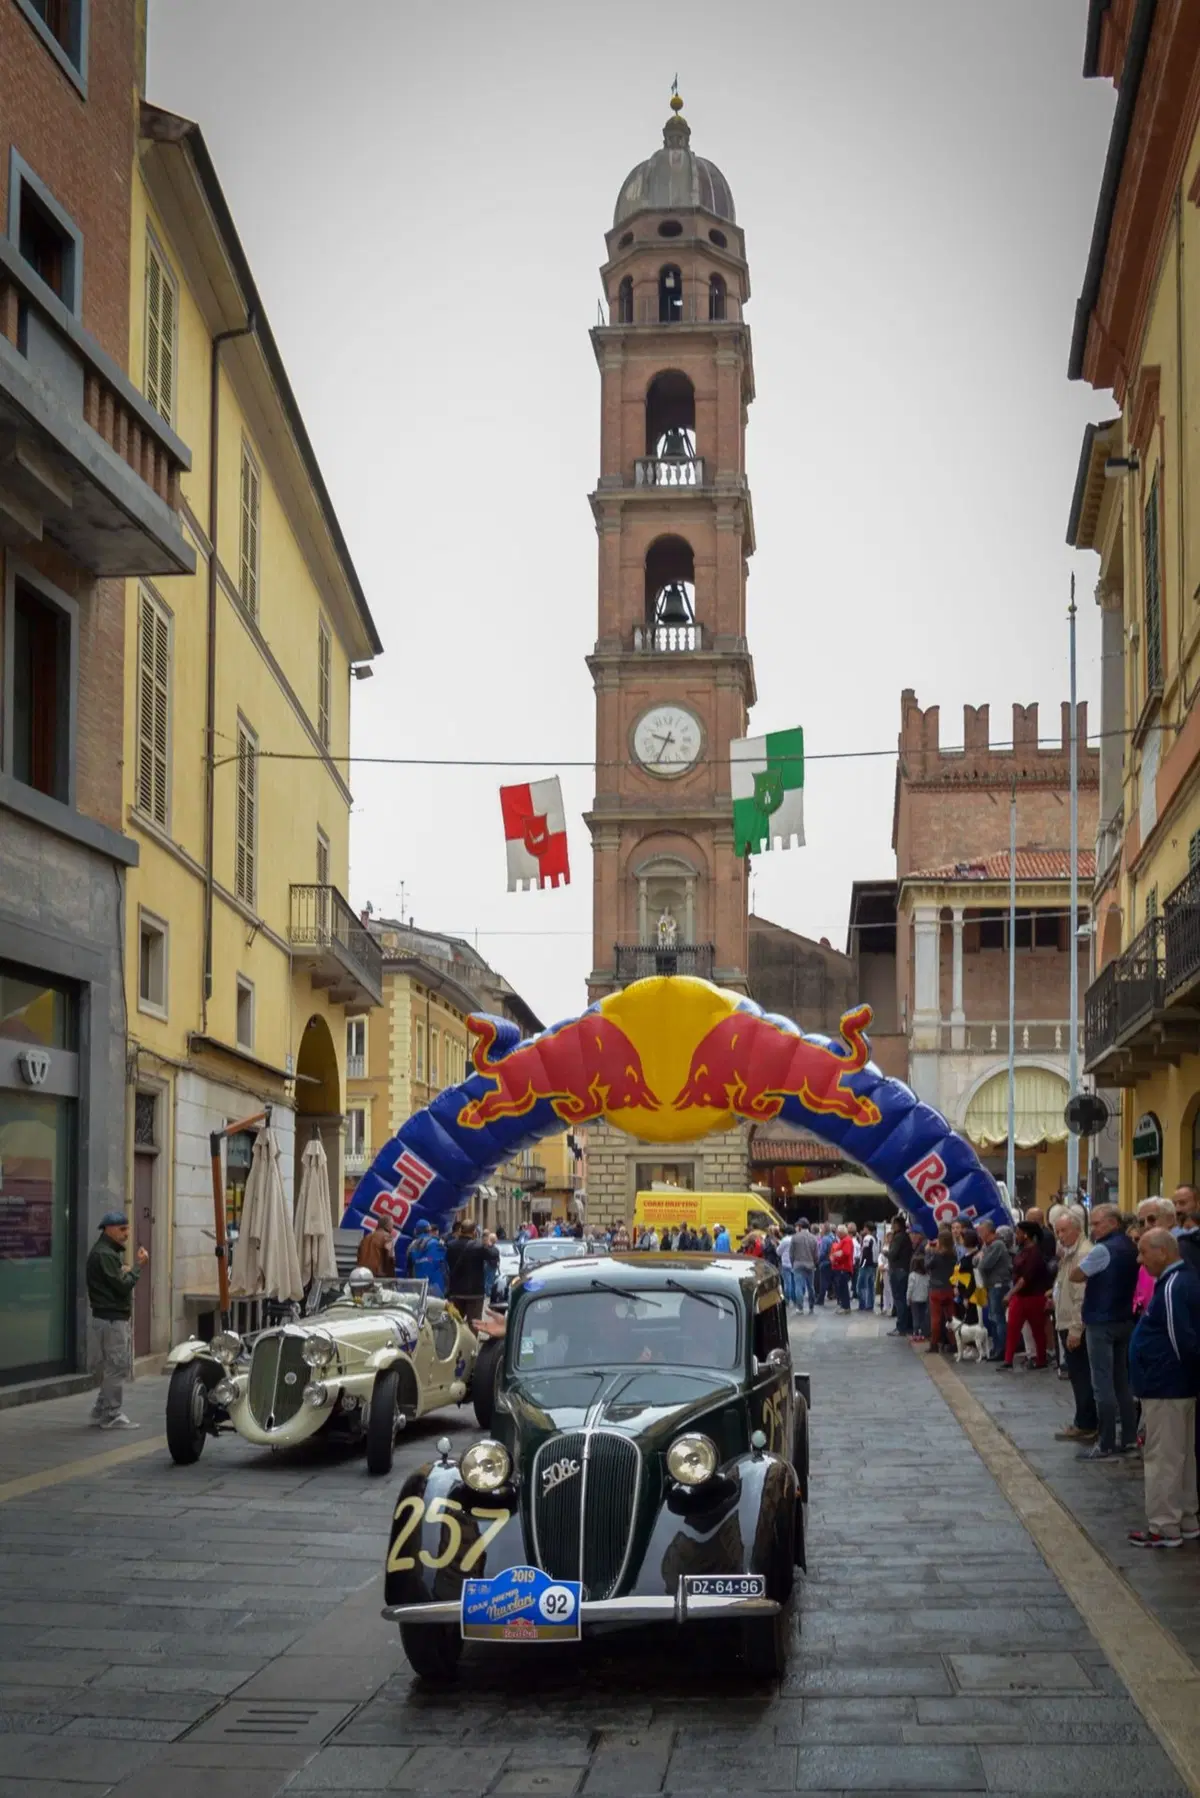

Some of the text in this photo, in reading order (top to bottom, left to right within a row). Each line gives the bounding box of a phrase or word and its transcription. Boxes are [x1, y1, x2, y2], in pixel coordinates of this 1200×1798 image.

[371, 1151, 436, 1228] Bull
[387, 1496, 510, 1572] 257
[511, 1569, 535, 1583] 2019
[546, 1594, 567, 1614] 92
